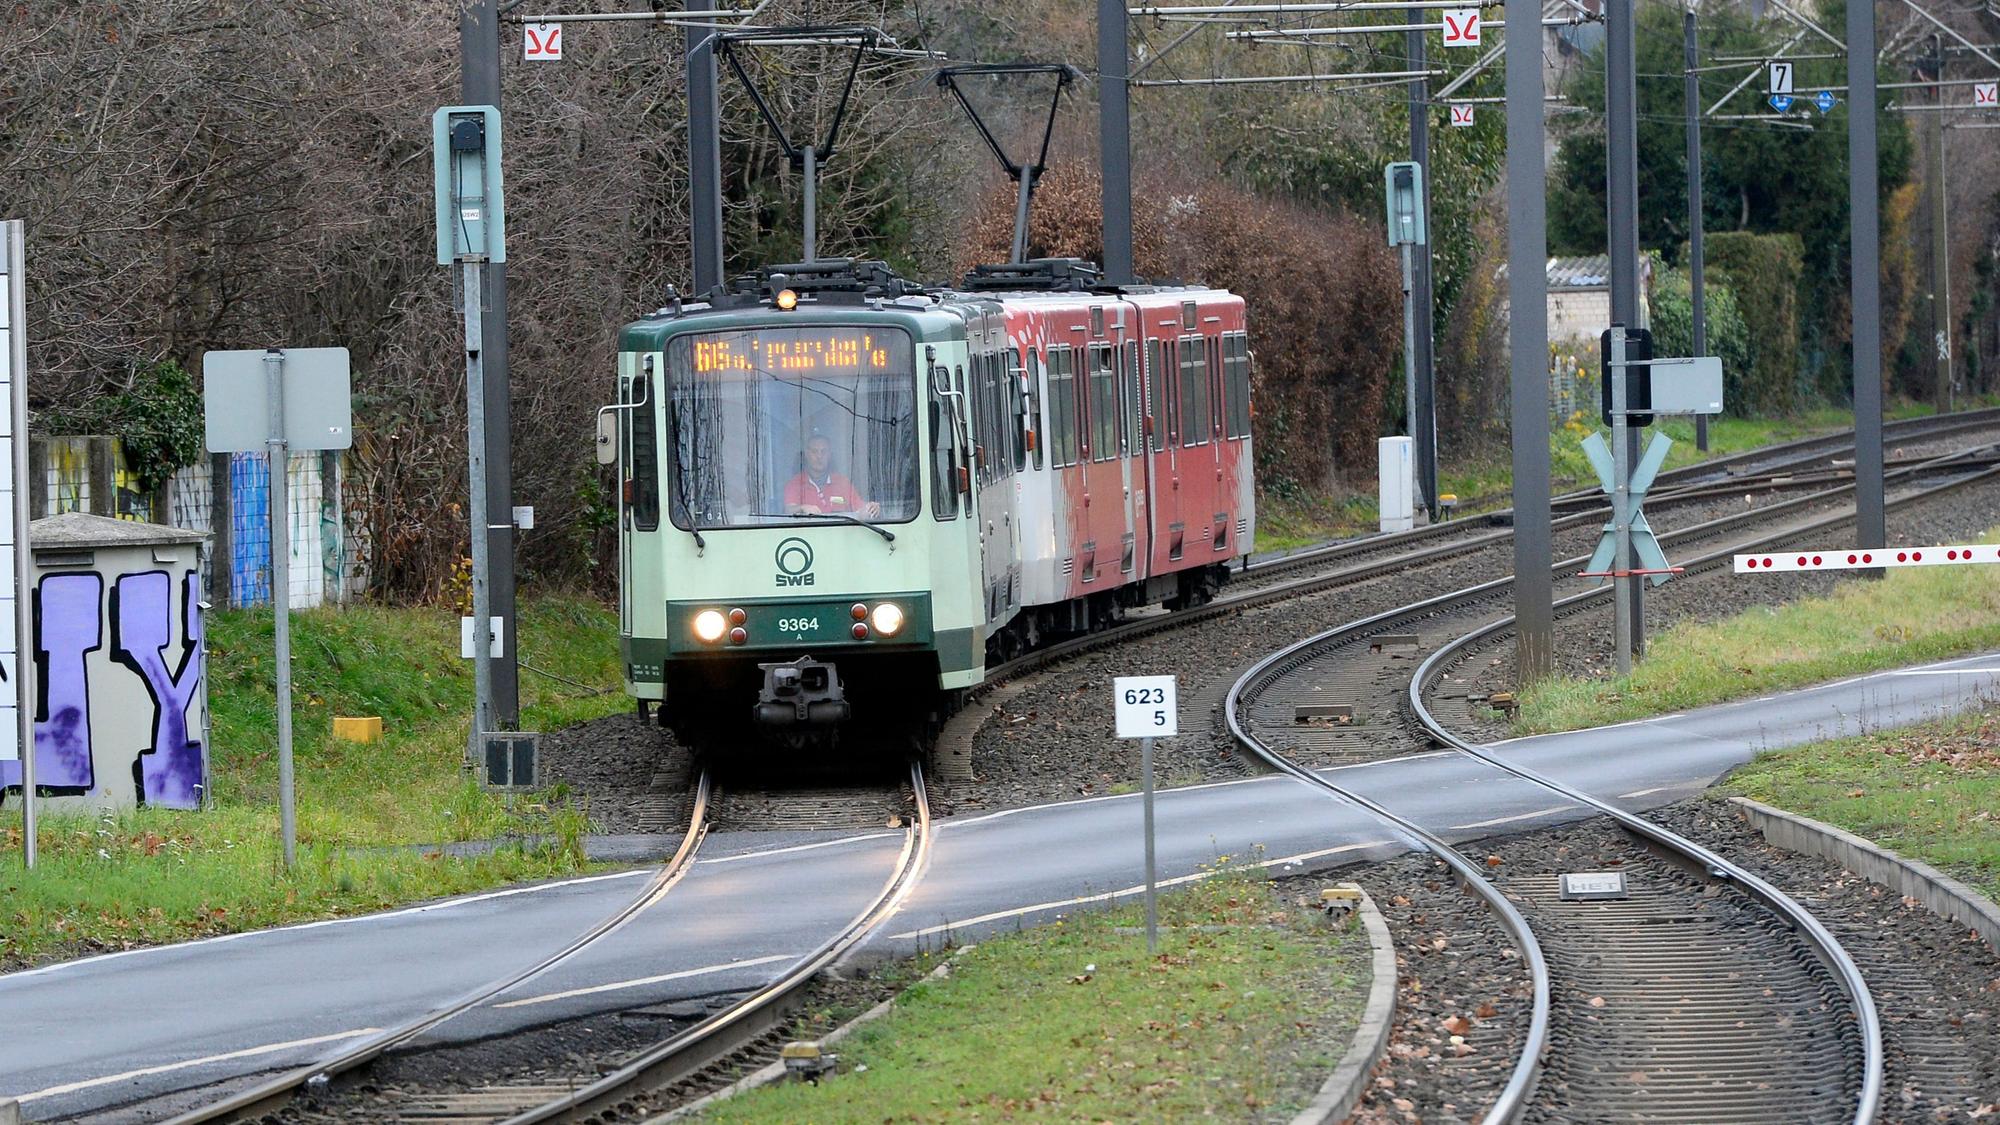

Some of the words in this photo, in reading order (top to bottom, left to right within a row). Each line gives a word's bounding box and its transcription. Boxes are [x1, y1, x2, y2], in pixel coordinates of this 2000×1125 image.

[1775, 66, 1787, 91] 7
[775, 572, 814, 587] SWB
[778, 617, 819, 632] 9364
[796, 633, 803, 641] A
[1125, 688, 1164, 705] 623
[1154, 710, 1165, 726] 5
